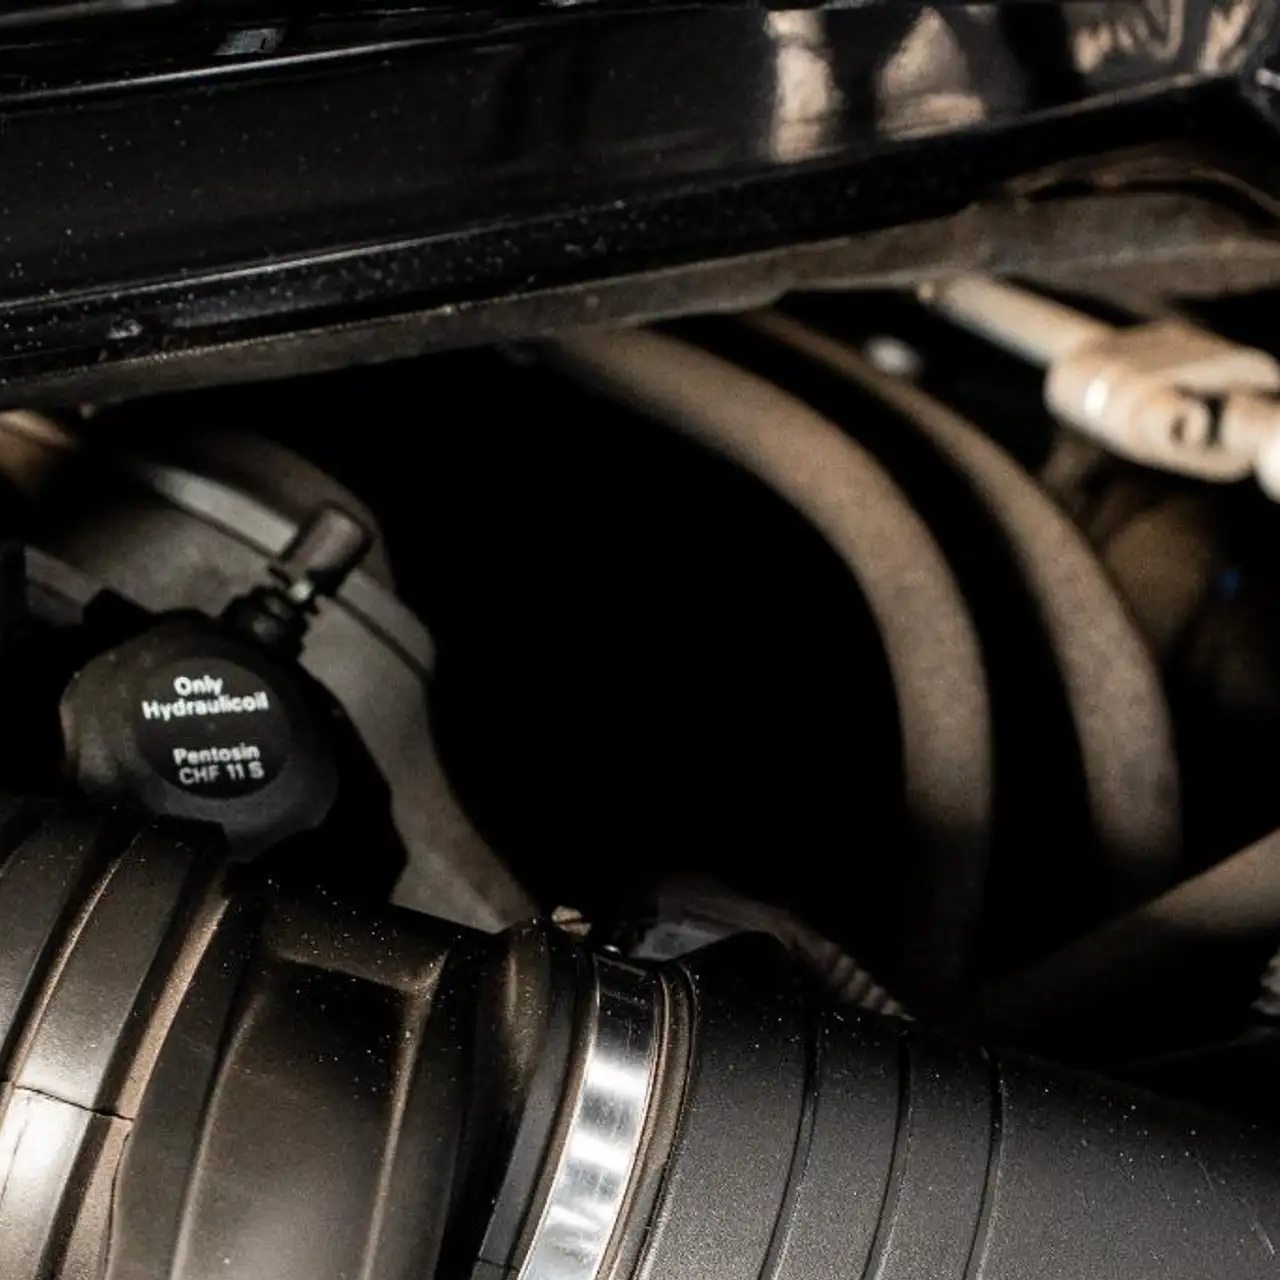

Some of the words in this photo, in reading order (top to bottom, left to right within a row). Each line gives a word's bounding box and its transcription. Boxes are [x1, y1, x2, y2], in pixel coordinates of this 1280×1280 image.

[173, 674, 223, 697] Only
[141, 691, 269, 721] Hydraulicoil
[172, 742, 260, 766] Pentosin
[179, 765, 221, 785] CHF
[227, 763, 245, 780] 11
[248, 760, 265, 779] S
